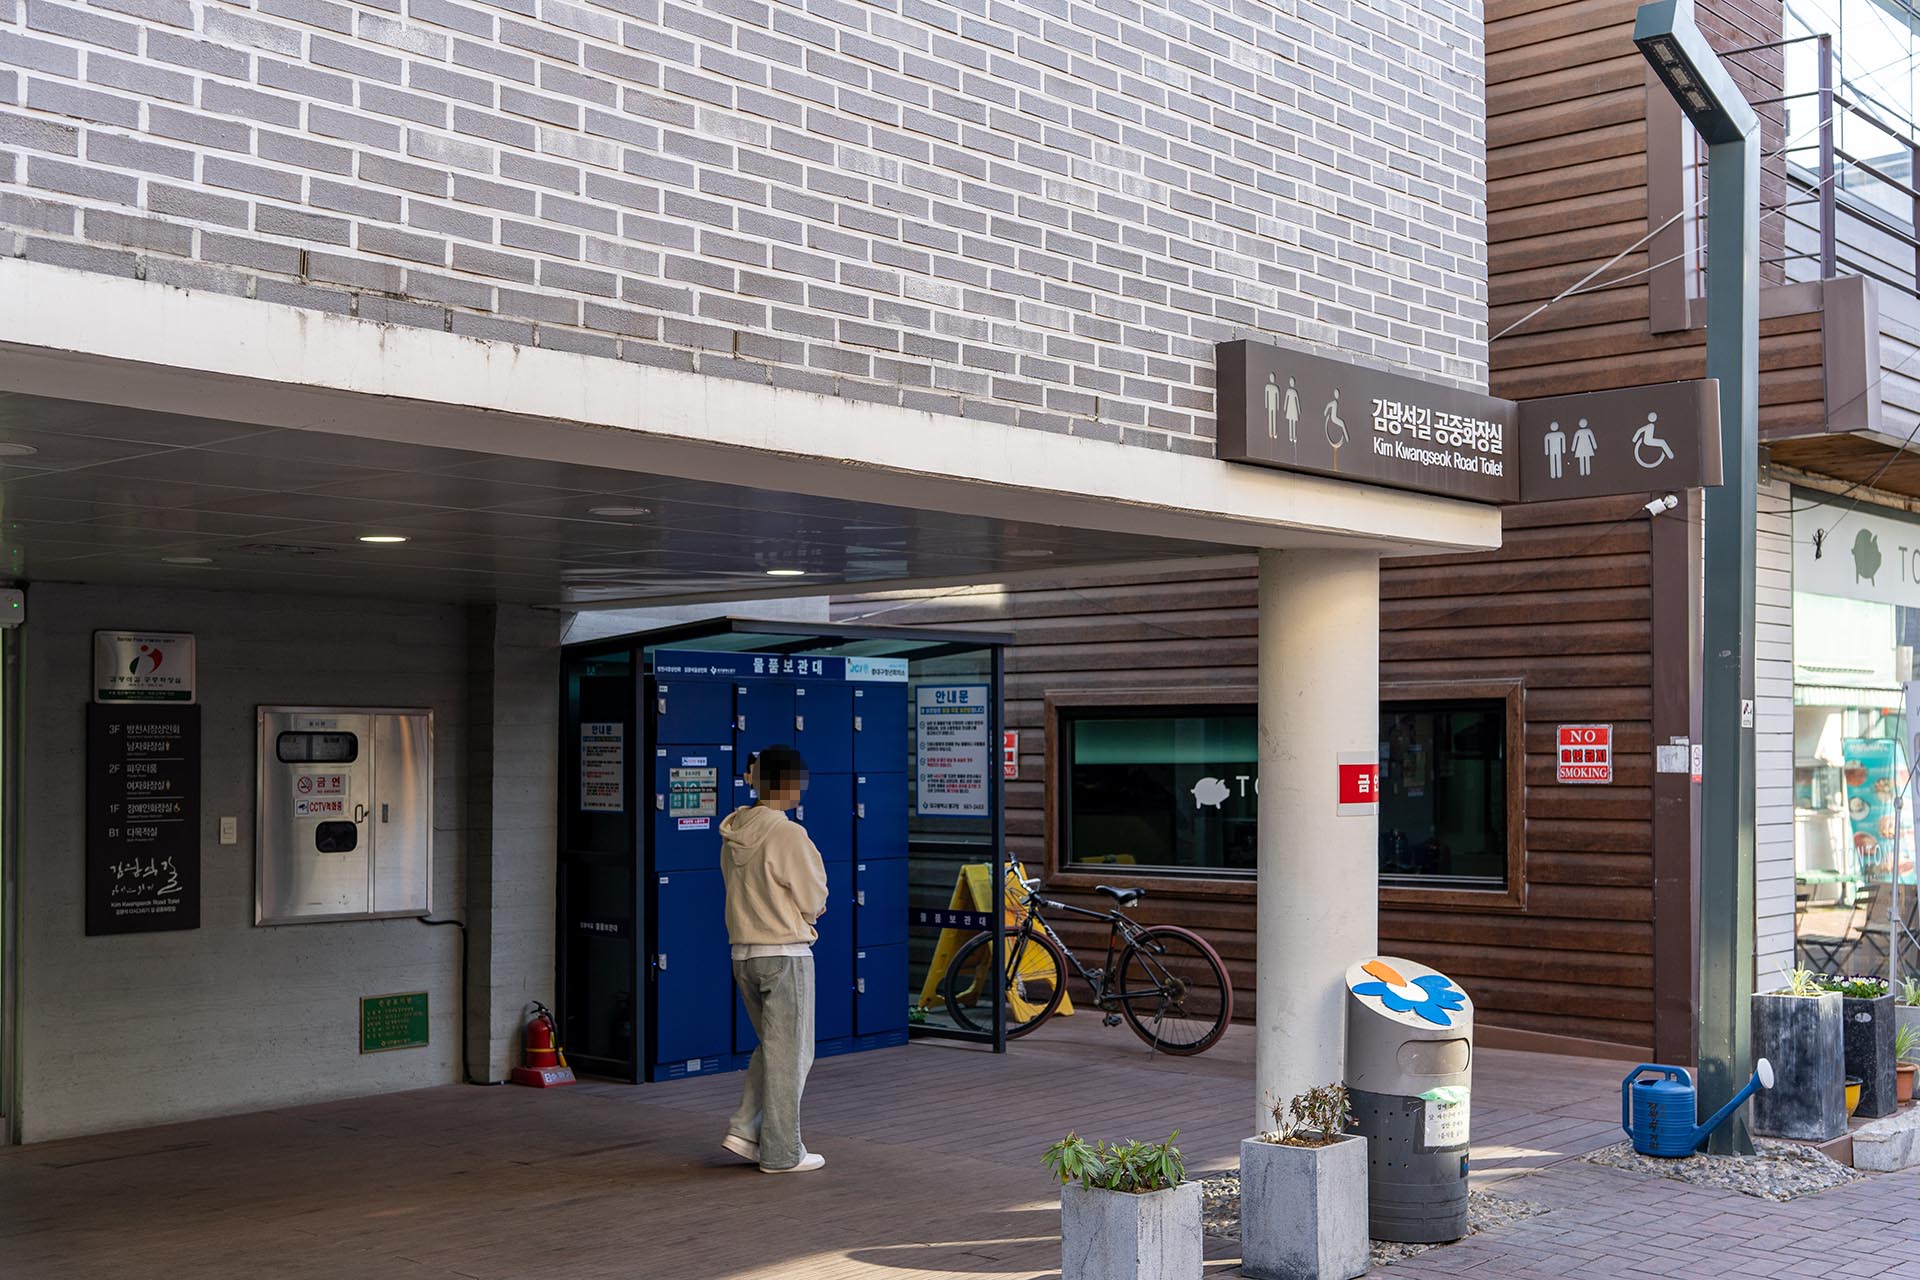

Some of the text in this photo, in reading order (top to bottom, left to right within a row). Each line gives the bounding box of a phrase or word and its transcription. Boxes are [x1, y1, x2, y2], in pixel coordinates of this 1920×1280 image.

[1372, 398, 1503, 456] 김광석길 공중화장실
[1373, 436, 1504, 479] Kim Kwangseok Road Toilet
[753, 657, 823, 675] 물품보관대
[850, 664, 863, 673] JCI
[935, 690, 969, 704] 안내문
[109, 724, 180, 735] 3F 방천시장상인회
[591, 725, 612, 735] 안내문
[1570, 730, 1597, 743] NO
[127, 741, 165, 752] 남자화장실
[1561, 749, 1607, 763] 흡연금지
[109, 763, 157, 774] 2F 파우더룸
[1560, 767, 1608, 779] SMOKING
[127, 780, 165, 791] 여자화장실
[317, 776, 341, 788] 금연
[1235, 776, 1259, 798] T
[110, 803, 172, 814] 1F 장애인화장실
[109, 826, 158, 838] B1 다목적실
[920, 912, 987, 927] 물품보관대
